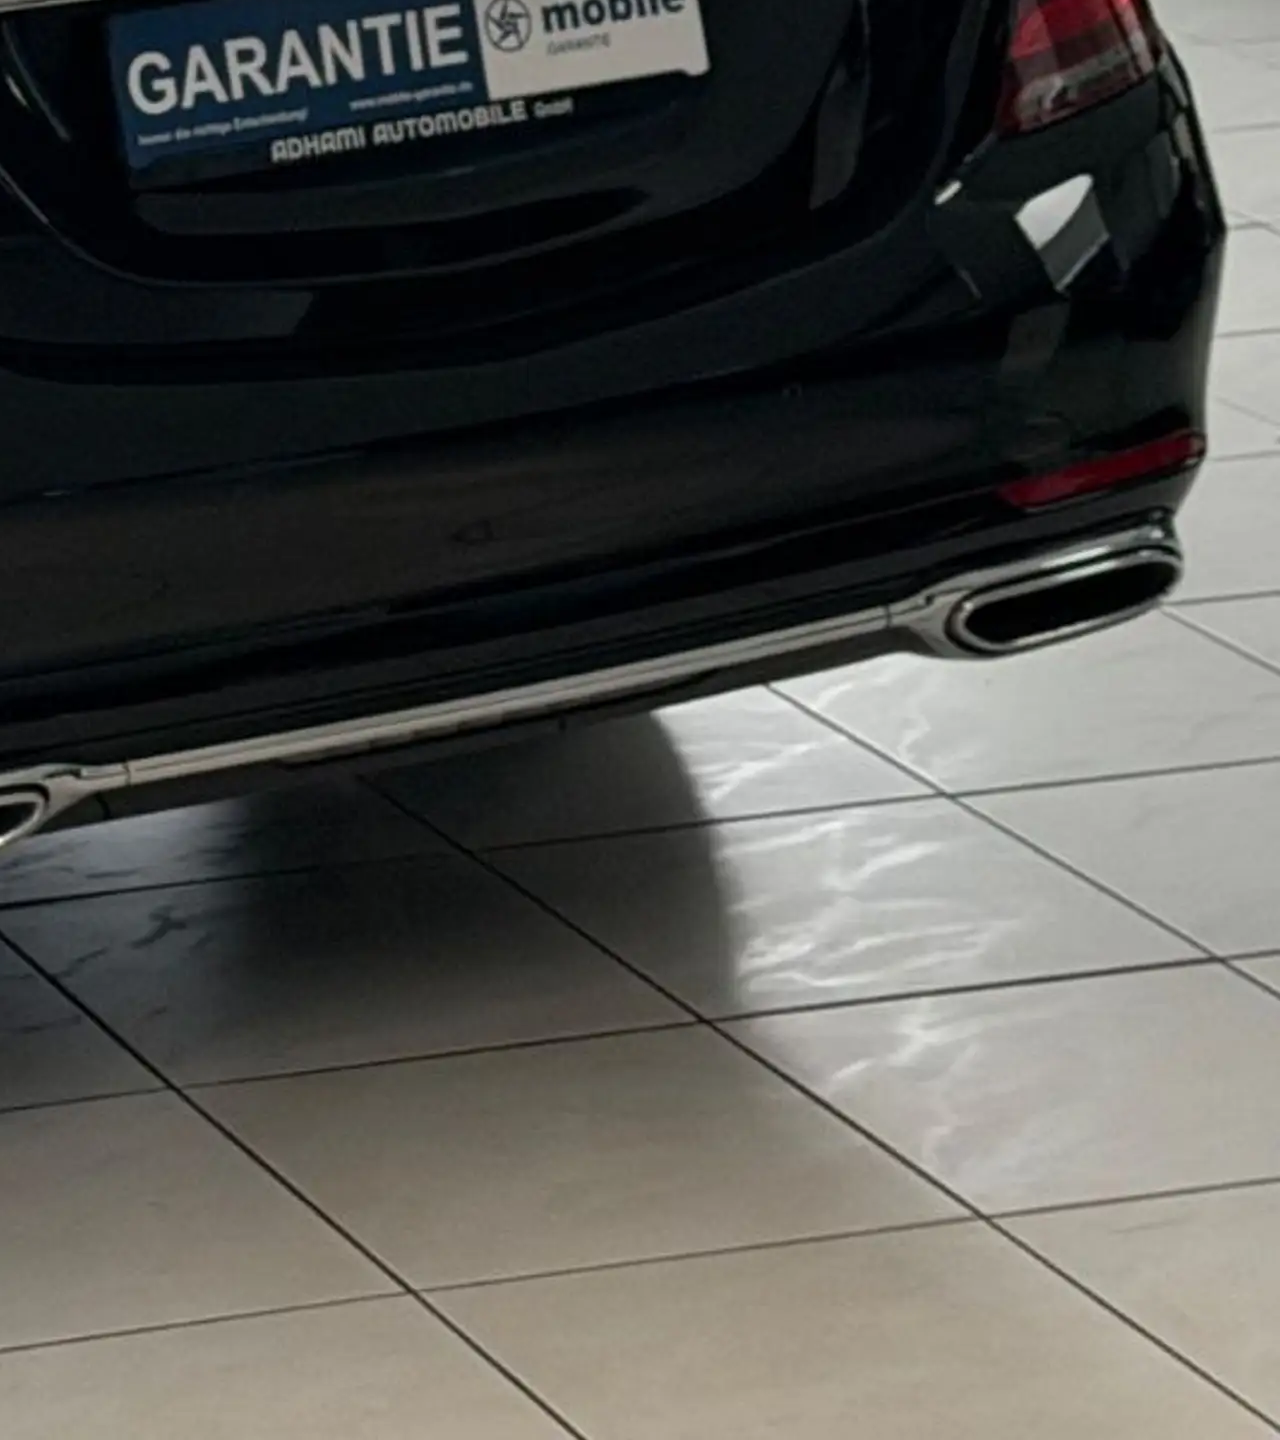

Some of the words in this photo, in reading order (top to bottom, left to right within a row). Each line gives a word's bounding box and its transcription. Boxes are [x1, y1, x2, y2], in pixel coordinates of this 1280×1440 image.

[127, 3, 469, 115] GARANTIE
[271, 125, 366, 163] ADHAMI
[372, 100, 528, 146] AUTOMOBILE
